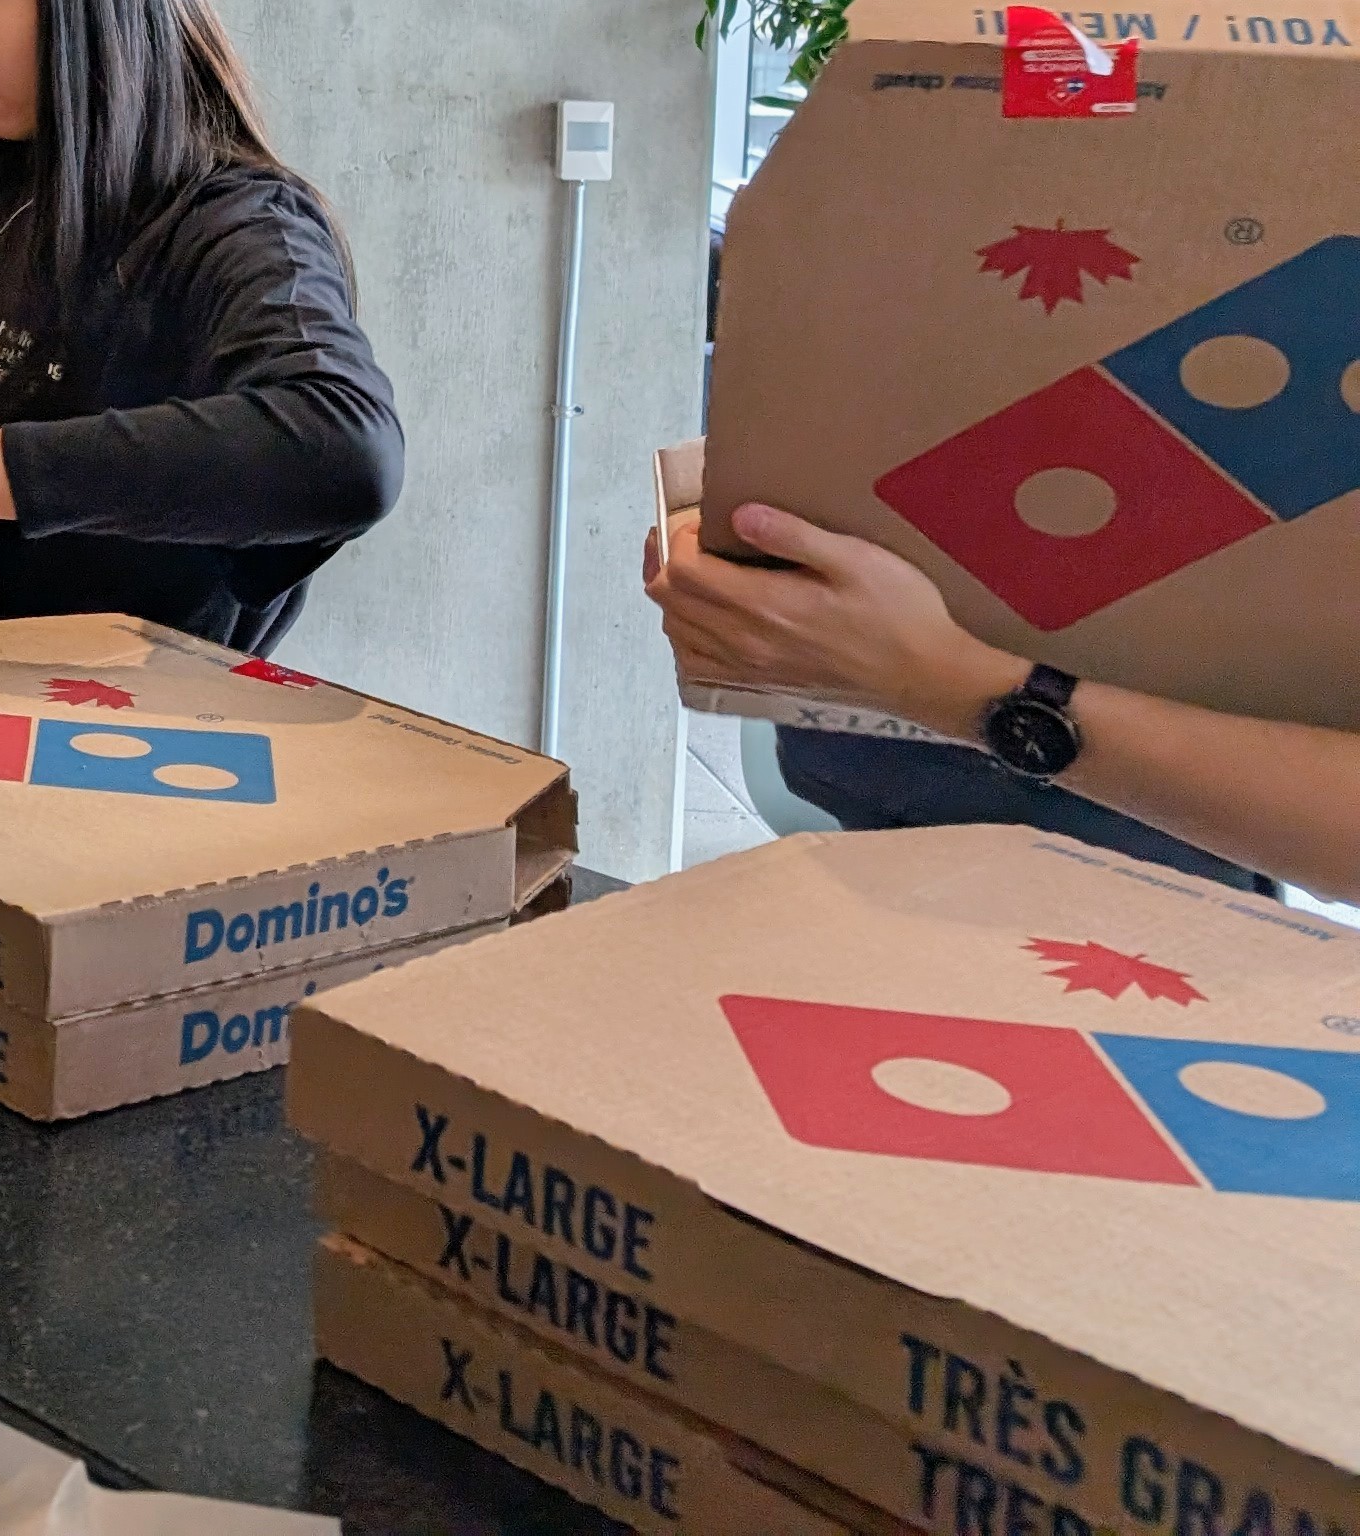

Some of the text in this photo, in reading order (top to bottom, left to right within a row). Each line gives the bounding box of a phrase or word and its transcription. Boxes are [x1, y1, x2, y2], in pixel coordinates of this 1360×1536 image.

[1228, 15, 1351, 47] YOU!
[184, 867, 409, 964] Domino's
[411, 1100, 1346, 1536] X-LARGE TRÈS GRA
[438, 1202, 679, 1382] X-LARGE
[440, 1336, 682, 1522] X-LARGE
